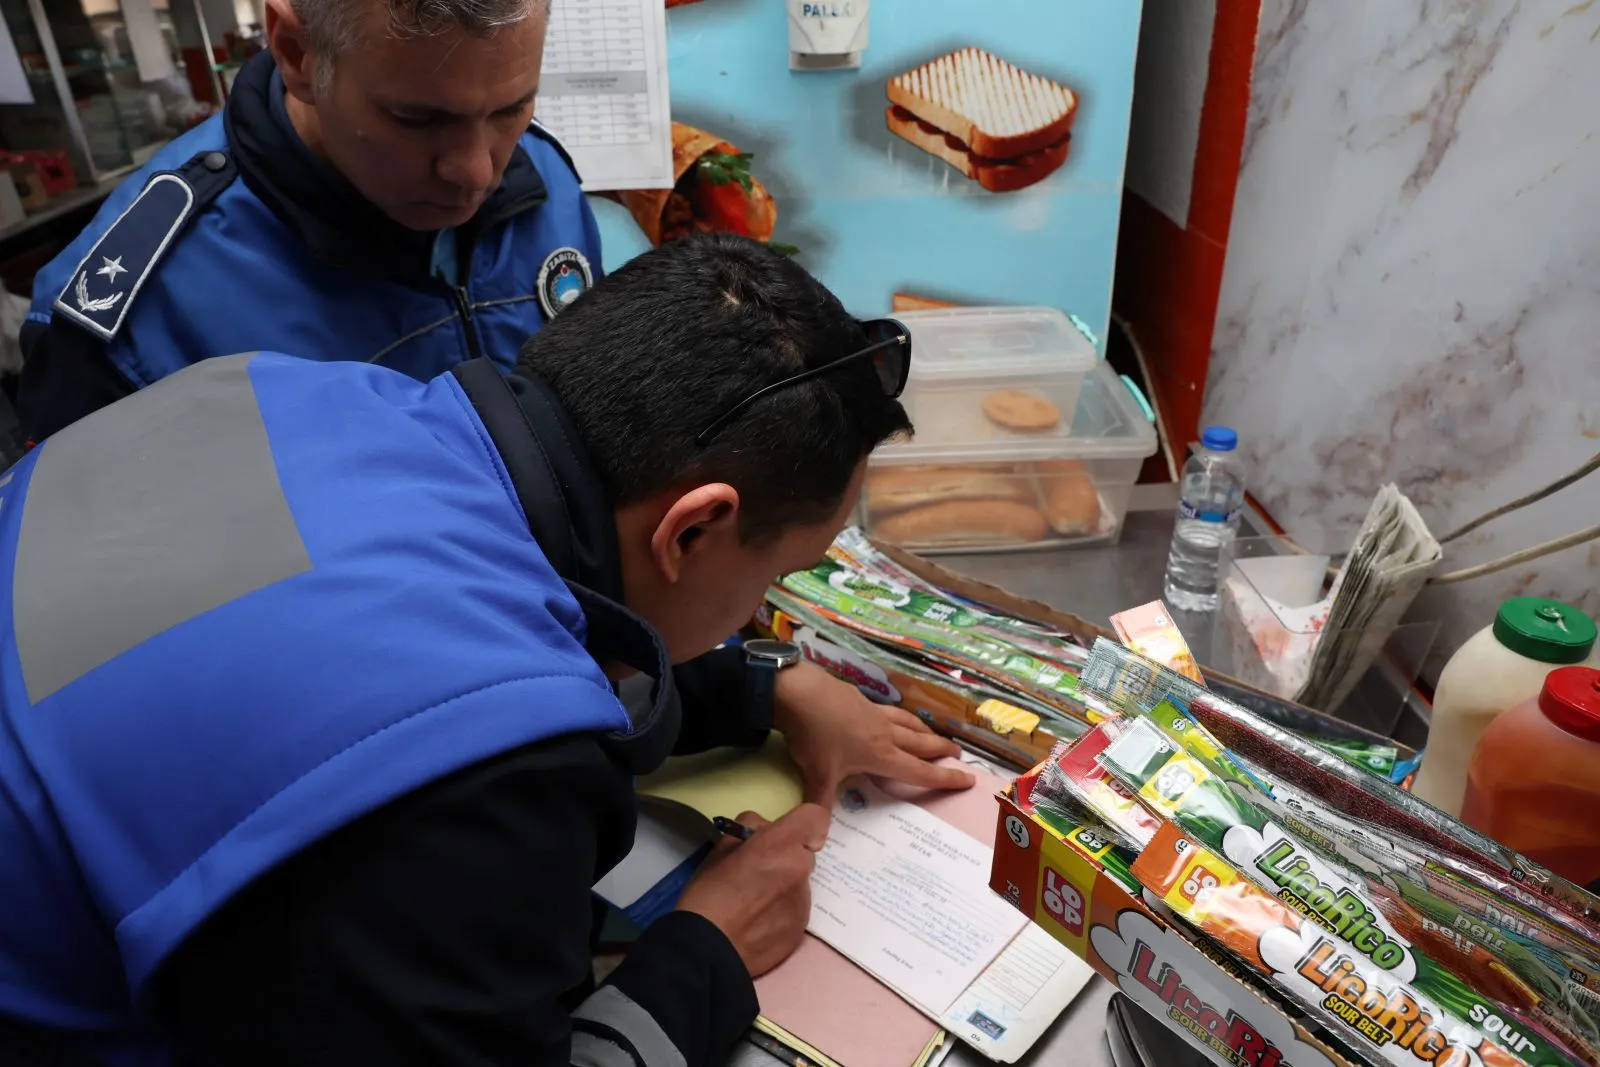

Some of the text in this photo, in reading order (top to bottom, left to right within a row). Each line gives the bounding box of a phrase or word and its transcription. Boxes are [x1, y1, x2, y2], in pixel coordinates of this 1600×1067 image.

[1255, 839, 1405, 970] LicoRico
[1280, 890, 1309, 912] SOUR
[1129, 938, 1286, 1067] LicoRi
[1296, 938, 1470, 1067] LicoRico
[1325, 996, 1391, 1046] SOUR BELT
[1468, 1003, 1536, 1053] sour
[1170, 1005, 1248, 1067] SOUR BELT
